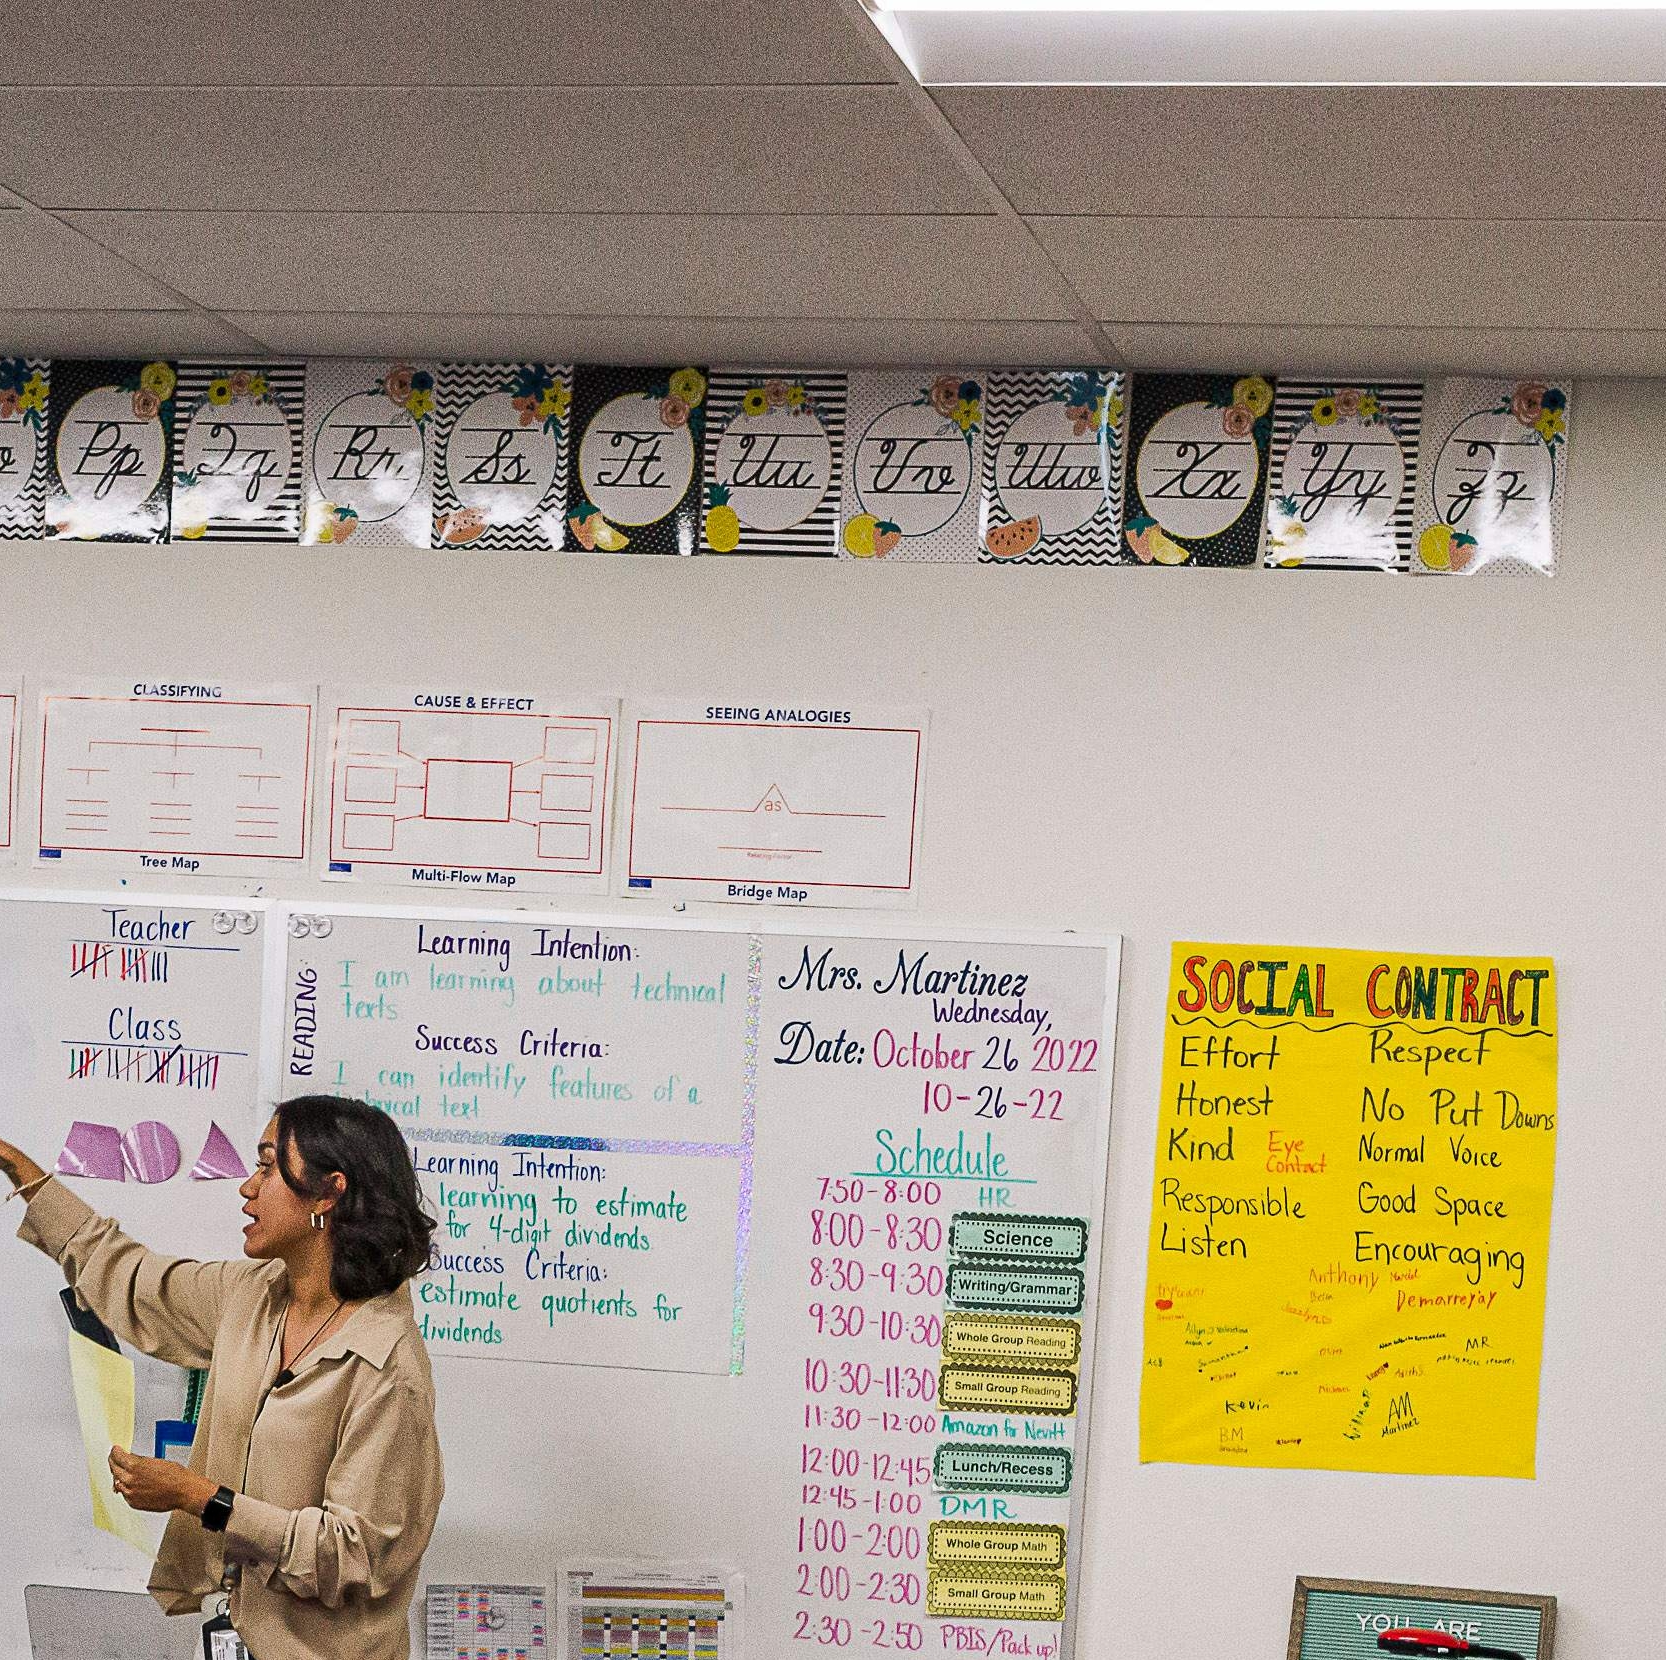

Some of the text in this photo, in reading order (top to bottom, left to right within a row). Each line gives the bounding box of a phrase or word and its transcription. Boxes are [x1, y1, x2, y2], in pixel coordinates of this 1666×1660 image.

[134, 684, 221, 698] CLASSIFYING
[414, 695, 533, 710] CAUSE & EFFECT
[707, 707, 850, 723] SEEING ANALOGIES
[140, 856, 199, 871] Tree Map
[412, 869, 516, 887] Multi-Flow Map
[728, 885, 807, 902] Bridge Map
[102, 909, 197, 942] Teacher
[418, 925, 641, 972] Learning Intention:
[778, 945, 1030, 998] Mrs. Martinez
[1178, 955, 1551, 1027] SOCIAL CONTRACT
[108, 1006, 183, 1042] Class
[932, 998, 1054, 1037] Wednesday,
[415, 1025, 611, 1059] Success Criteria:
[773, 1020, 1100, 1074] Date: October 26 2022
[1179, 1035, 1281, 1070] Effort
[1369, 1030, 1492, 1076] Respect
[1176, 1080, 1275, 1118] Honest
[1361, 1086, 1555, 1132] No Put Downs
[876, 1127, 1010, 1177] Schedule
[1167, 1126, 1235, 1163] Kind
[1268, 1129, 1305, 1154] Eye
[1358, 1132, 1503, 1169] Normal Voice
[414, 1147, 608, 1192] Learning Intention:
[1265, 1153, 1328, 1175] Contact
[1160, 1177, 1306, 1227] Responsible
[1357, 1181, 1509, 1227] Good Space
[983, 1229, 1054, 1248] Science
[1160, 1222, 1248, 1259] Listen
[1354, 1230, 1526, 1290] Encouraging
[419, 1274, 685, 1328] estimate quotients for
[958, 1277, 1073, 1297] Writing/Grammar
[419, 1314, 504, 1345] dividends
[956, 1331, 1067, 1349] Whole Group Reading
[951, 1459, 1054, 1477] Lunch/Recess
[947, 1588, 1046, 1602] Small Group Math
